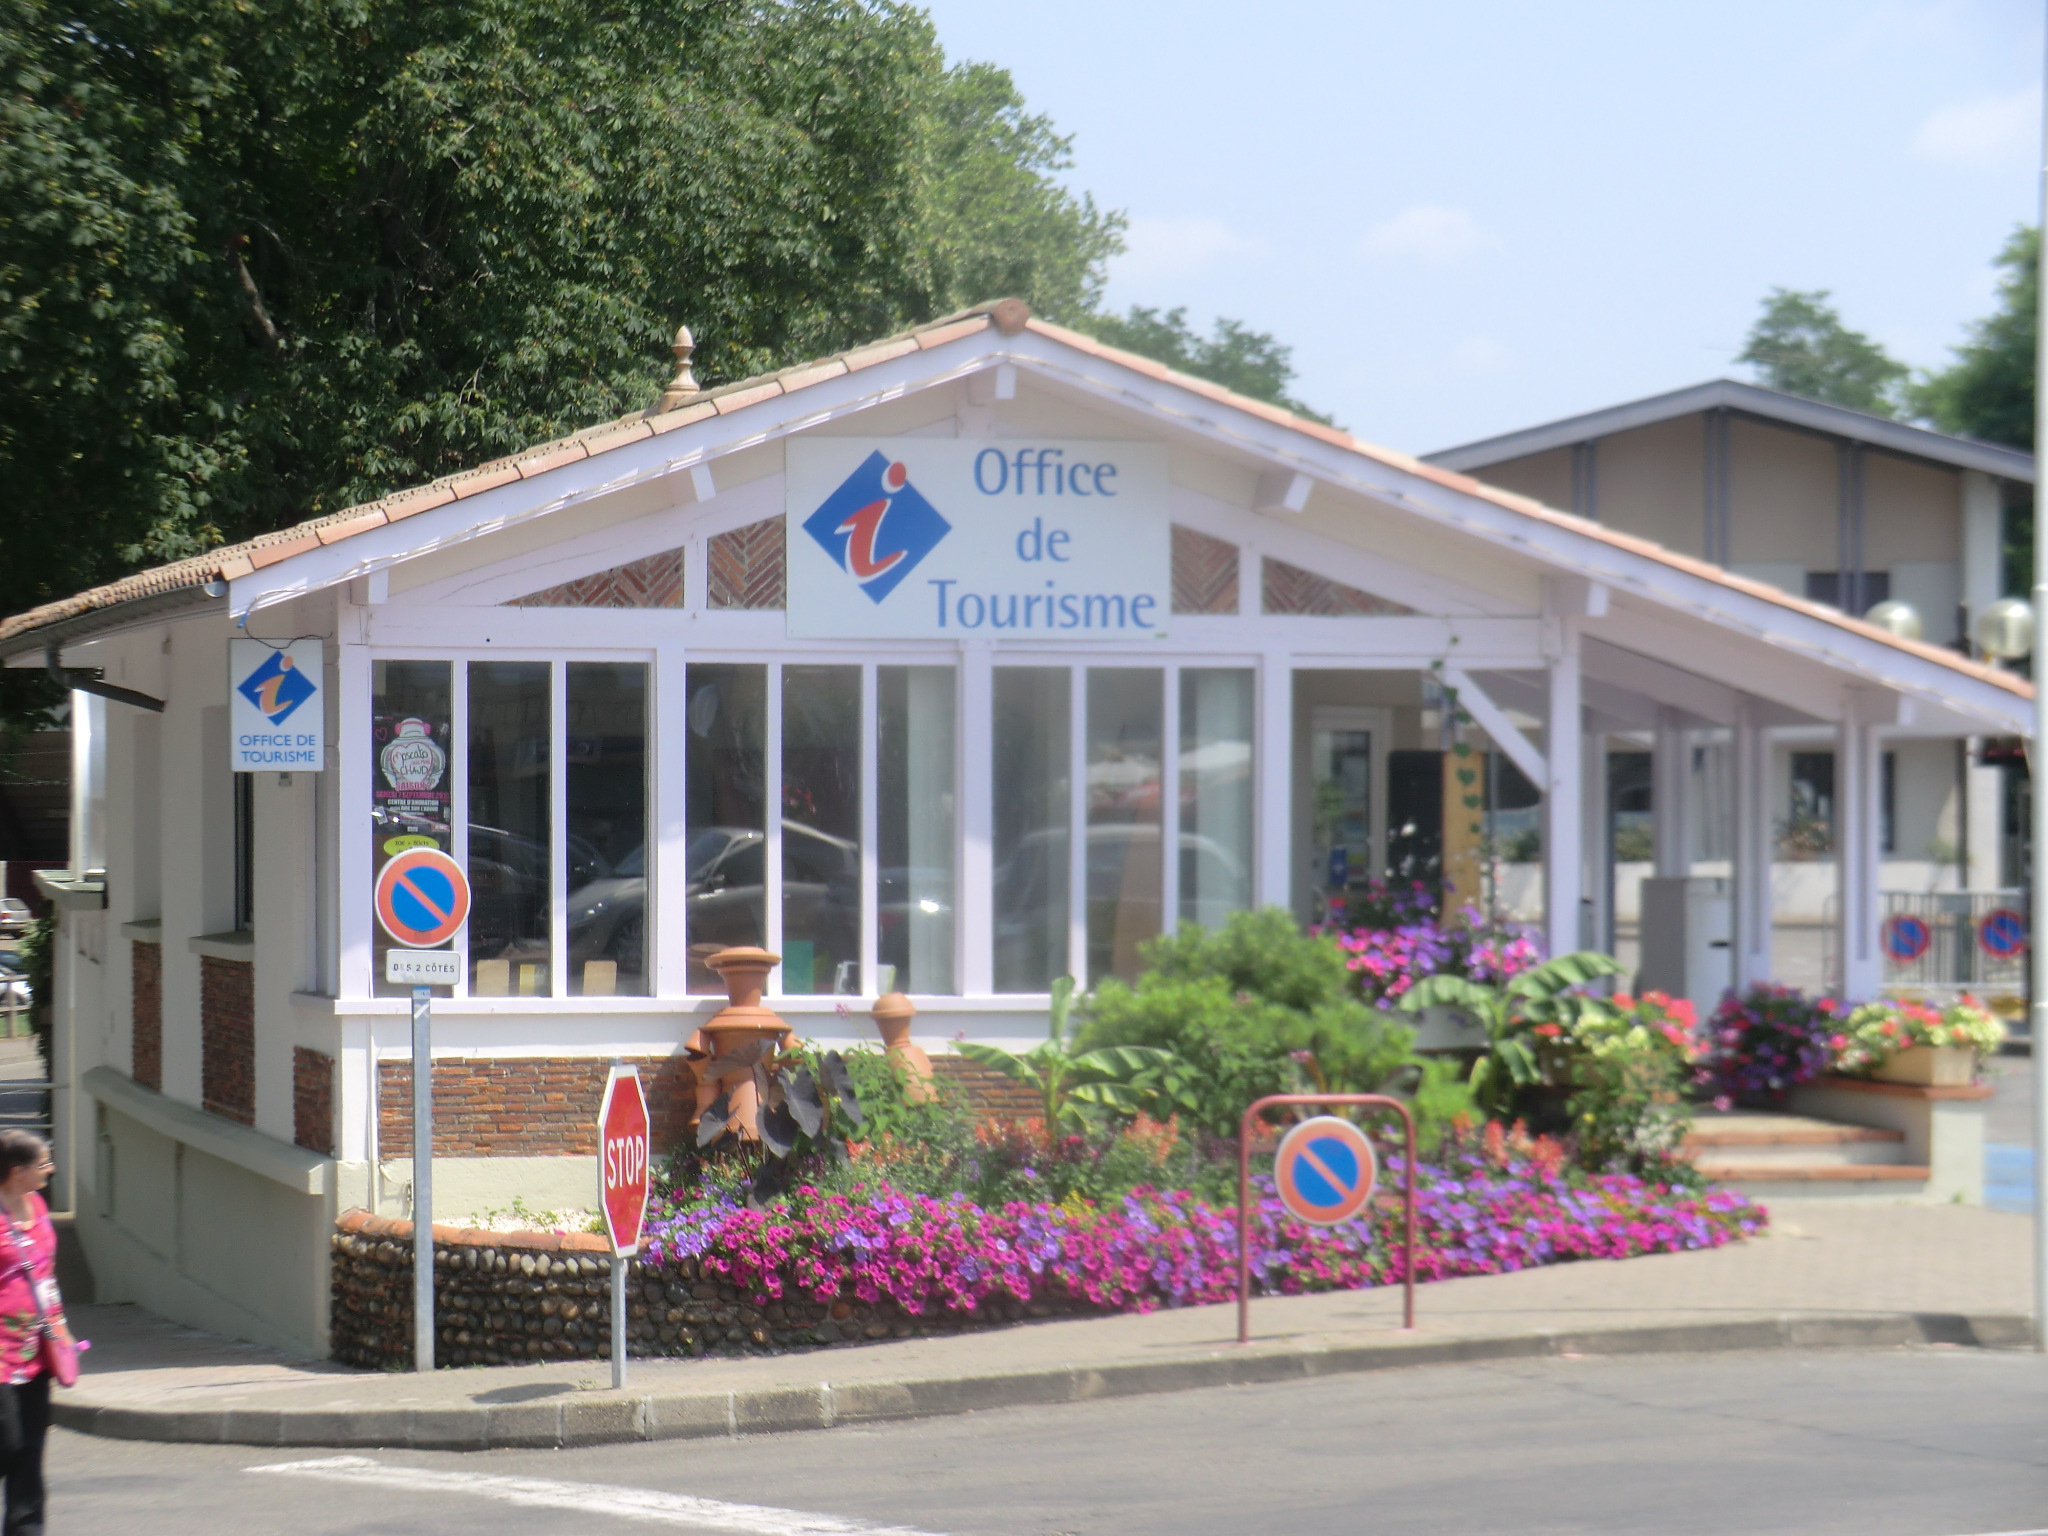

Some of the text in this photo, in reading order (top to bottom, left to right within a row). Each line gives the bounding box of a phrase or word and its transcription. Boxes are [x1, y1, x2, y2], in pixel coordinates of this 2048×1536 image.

[973, 448, 1119, 497] Office
[1016, 516, 1071, 563] de
[927, 579, 1157, 630] Tourisme
[239, 734, 316, 747] OFFICE DE
[241, 750, 316, 763] TOURISME
[416, 964, 421, 972] 2
[425, 962, 455, 973] CÔTÉS
[607, 1135, 645, 1190] STOP
